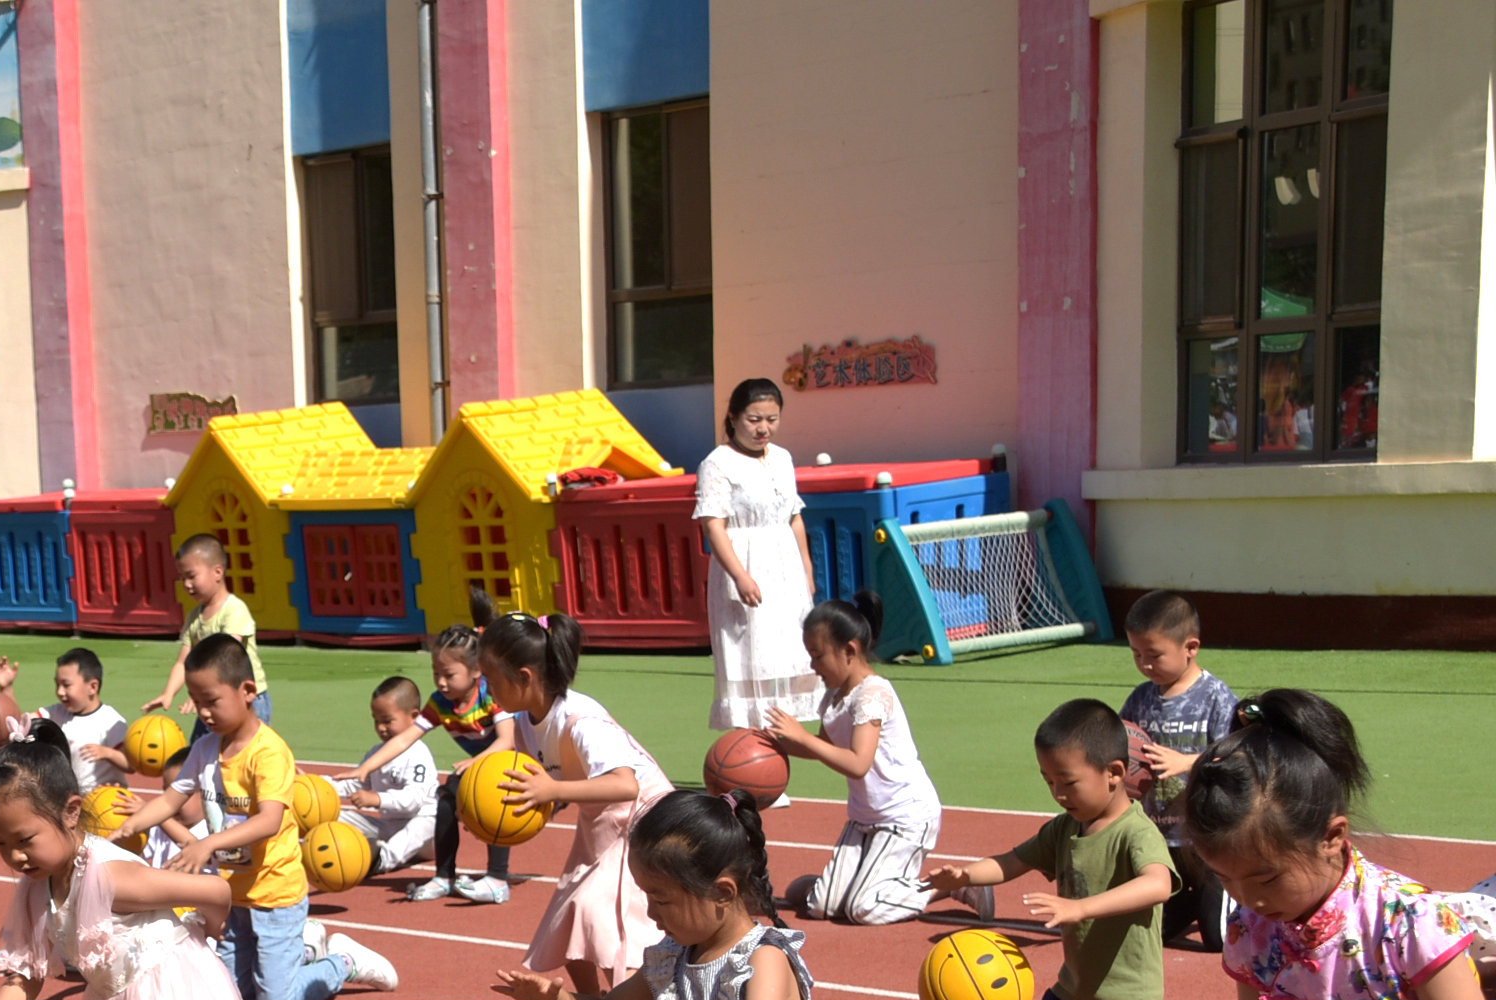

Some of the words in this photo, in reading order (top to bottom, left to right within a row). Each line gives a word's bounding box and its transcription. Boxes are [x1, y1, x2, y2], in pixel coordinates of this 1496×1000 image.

[811, 355, 914, 388] 艺术体验区
[412, 763, 427, 784] 8
